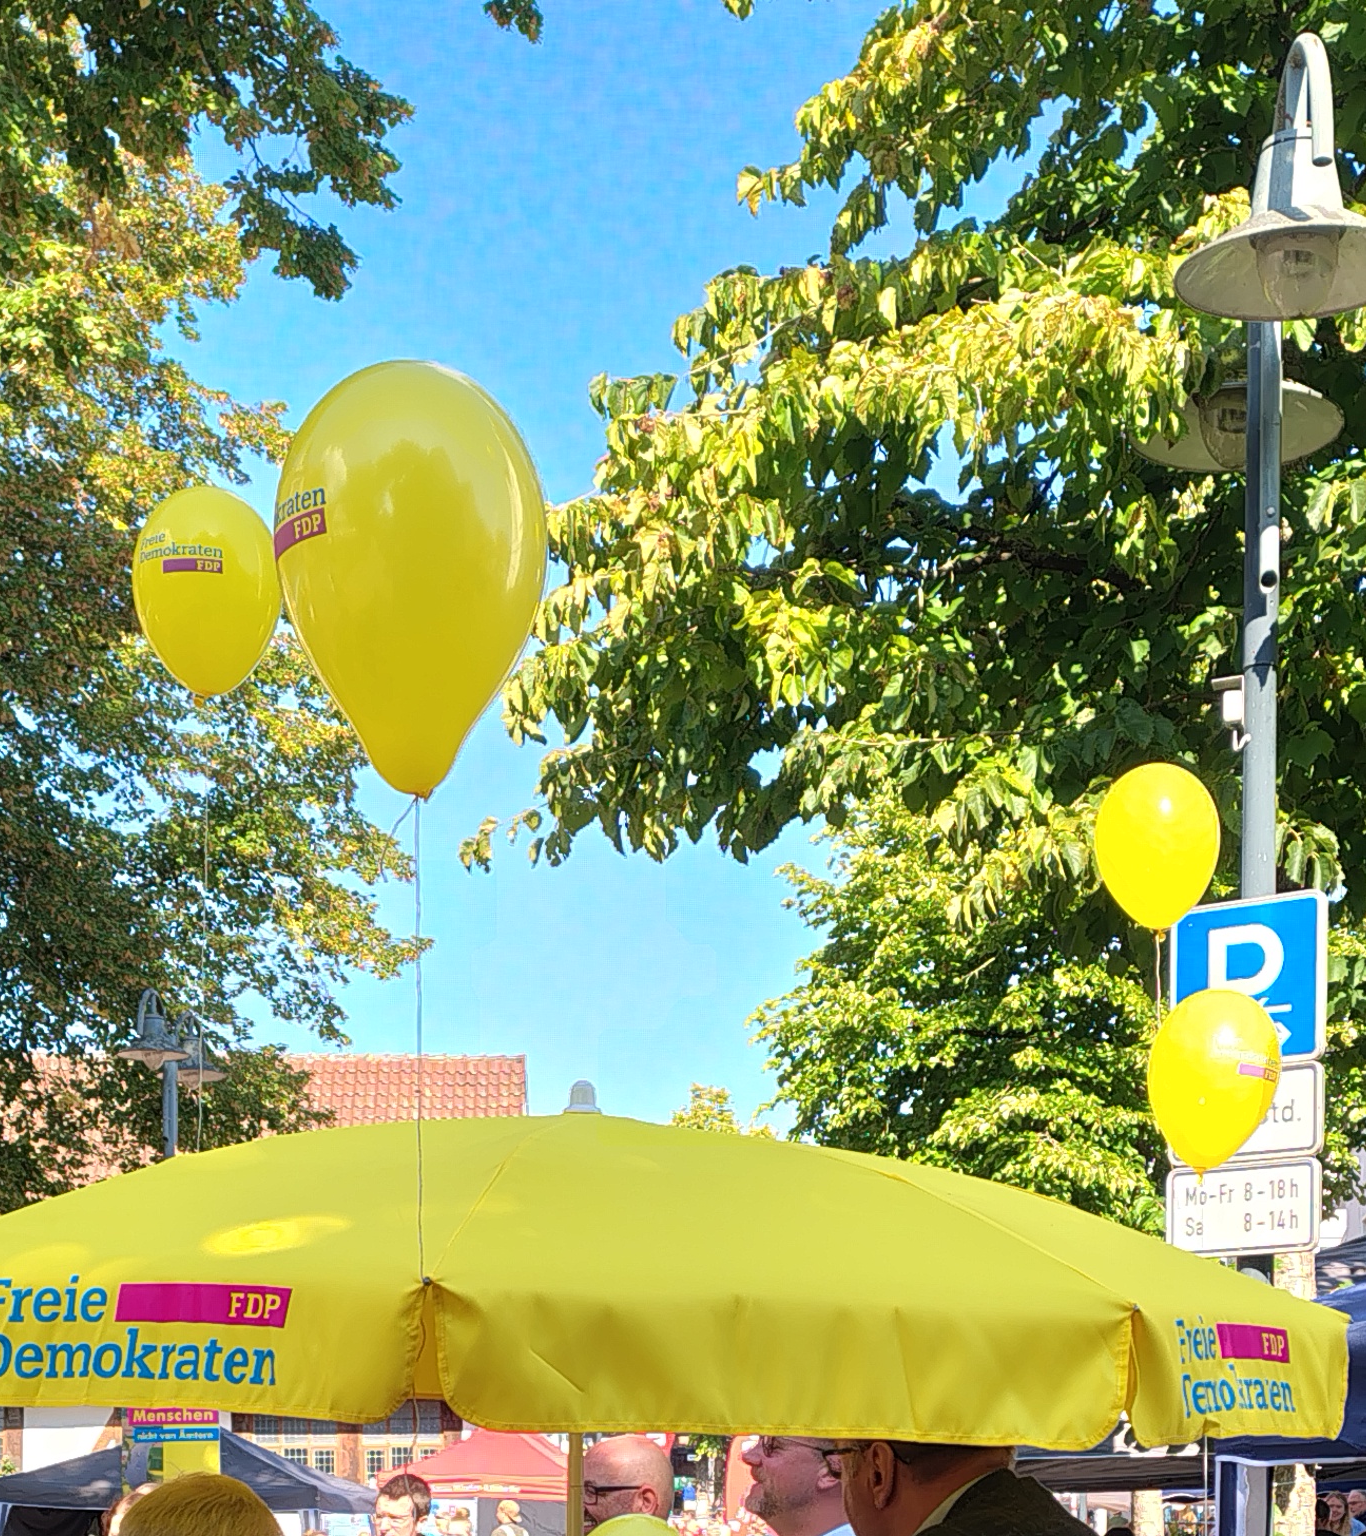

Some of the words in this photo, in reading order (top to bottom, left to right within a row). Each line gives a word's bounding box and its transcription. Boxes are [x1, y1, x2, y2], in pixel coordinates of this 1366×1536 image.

[293, 513, 322, 540] FDP
[140, 531, 166, 550] Freie
[139, 541, 223, 564] Demokraten
[196, 559, 221, 572] FDP
[1208, 922, 1285, 997] P
[1260, 1099, 1302, 1124] td.
[1185, 1183, 1235, 1206] Mo-Fr
[1186, 1217, 1204, 1236] Sa
[228, 1291, 281, 1319] FDP
[1261, 1332, 1285, 1357] FDP
[132, 1408, 214, 1422] Menschen
